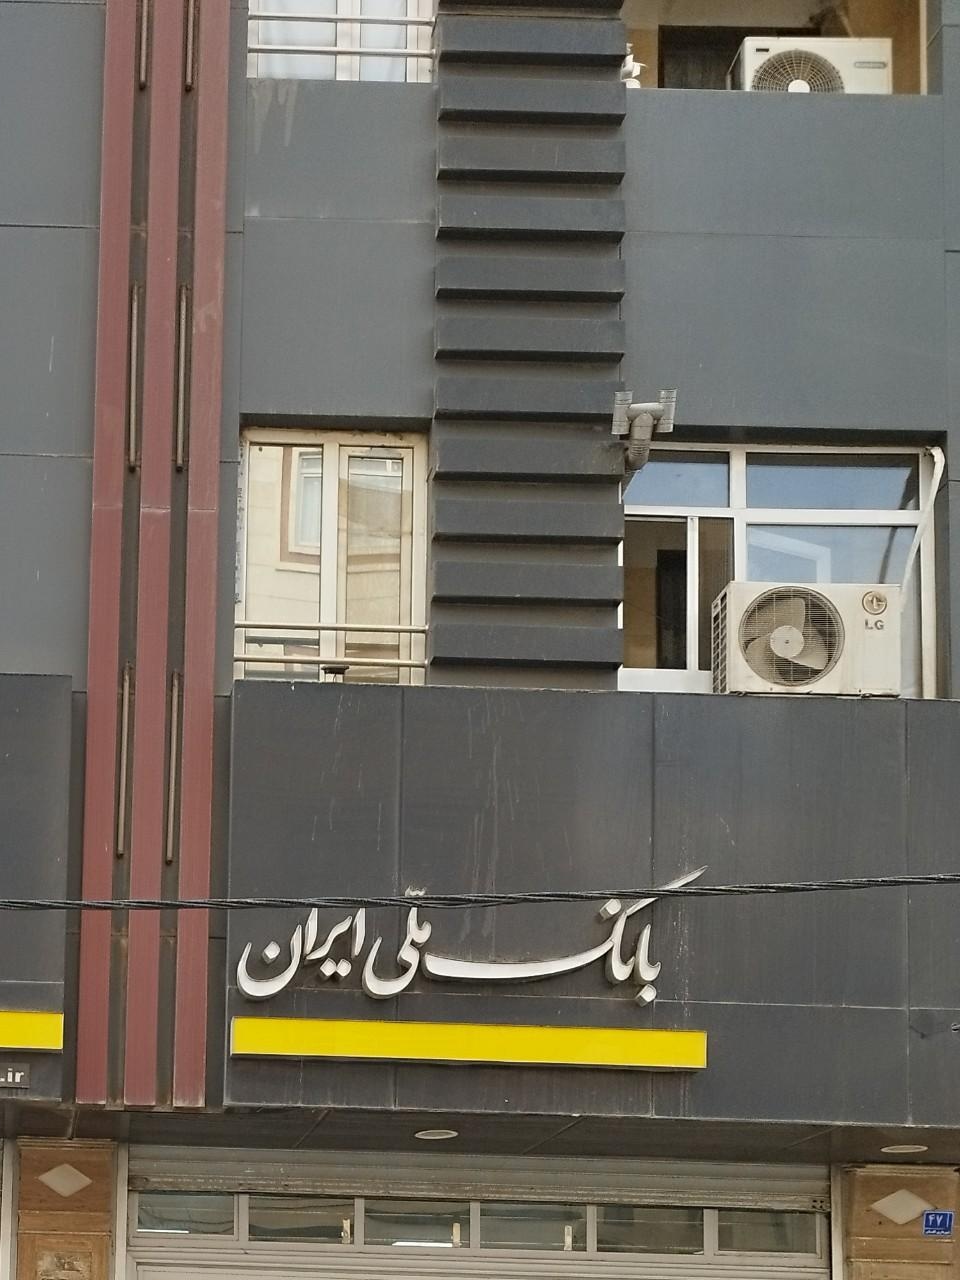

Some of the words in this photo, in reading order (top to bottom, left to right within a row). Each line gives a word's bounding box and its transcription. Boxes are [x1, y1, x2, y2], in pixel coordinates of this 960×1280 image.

[864, 619, 885, 631] LG
[236, 902, 366, 1000] ایران
[362, 886, 432, 1000] ملی
[424, 865, 708, 1007] بانک
